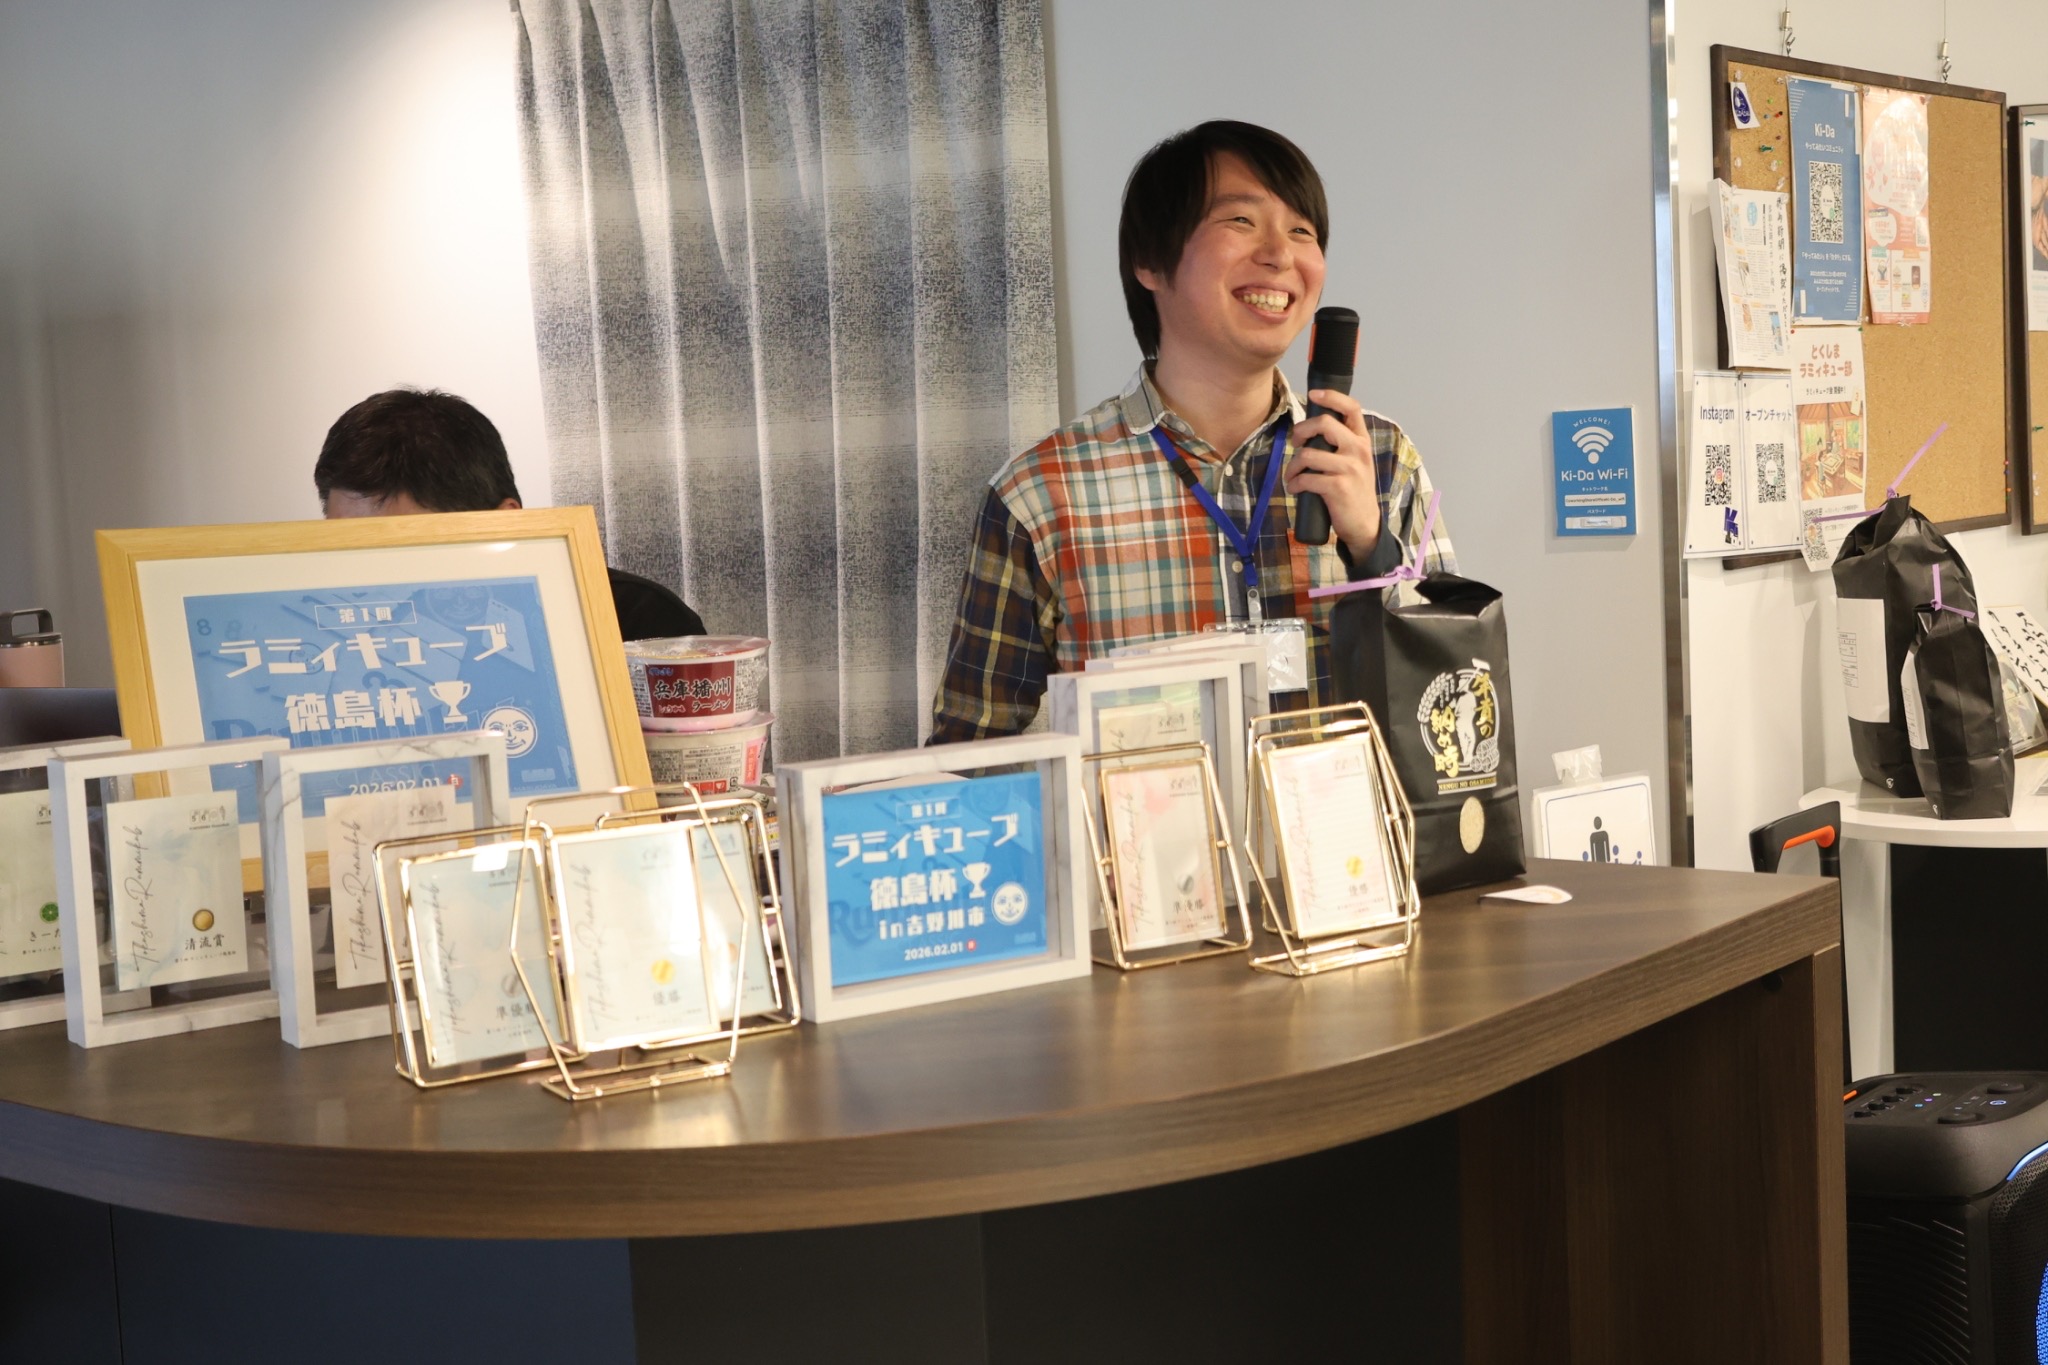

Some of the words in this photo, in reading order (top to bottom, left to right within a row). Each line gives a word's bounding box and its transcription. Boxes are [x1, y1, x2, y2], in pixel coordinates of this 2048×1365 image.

[1814, 123, 1835, 138] Ki-Da
[1811, 344, 1840, 360] とくしま
[1800, 361, 1853, 378] ラミィキュー部
[1573, 417, 1611, 427] WELCOME!
[1700, 406, 1734, 424] Instagram
[1745, 409, 1792, 421] オープンチャット
[1561, 470, 1594, 481] Ki-Da
[1597, 468, 1628, 479] Wi-Fi
[339, 606, 392, 624] 第1回
[218, 623, 507, 678] ラミィキューブ
[653, 676, 732, 701] 兵庫播州
[284, 687, 423, 734] 徳島杯
[692, 698, 731, 714] ラーメン
[1472, 672, 1495, 739] 年貢の
[911, 801, 947, 818] 第1回
[832, 813, 1019, 867] ラミィキューブ
[870, 868, 958, 911] 徳島杯
[185, 934, 225, 950] 清流賞
[904, 941, 964, 960] 2026.02.01
